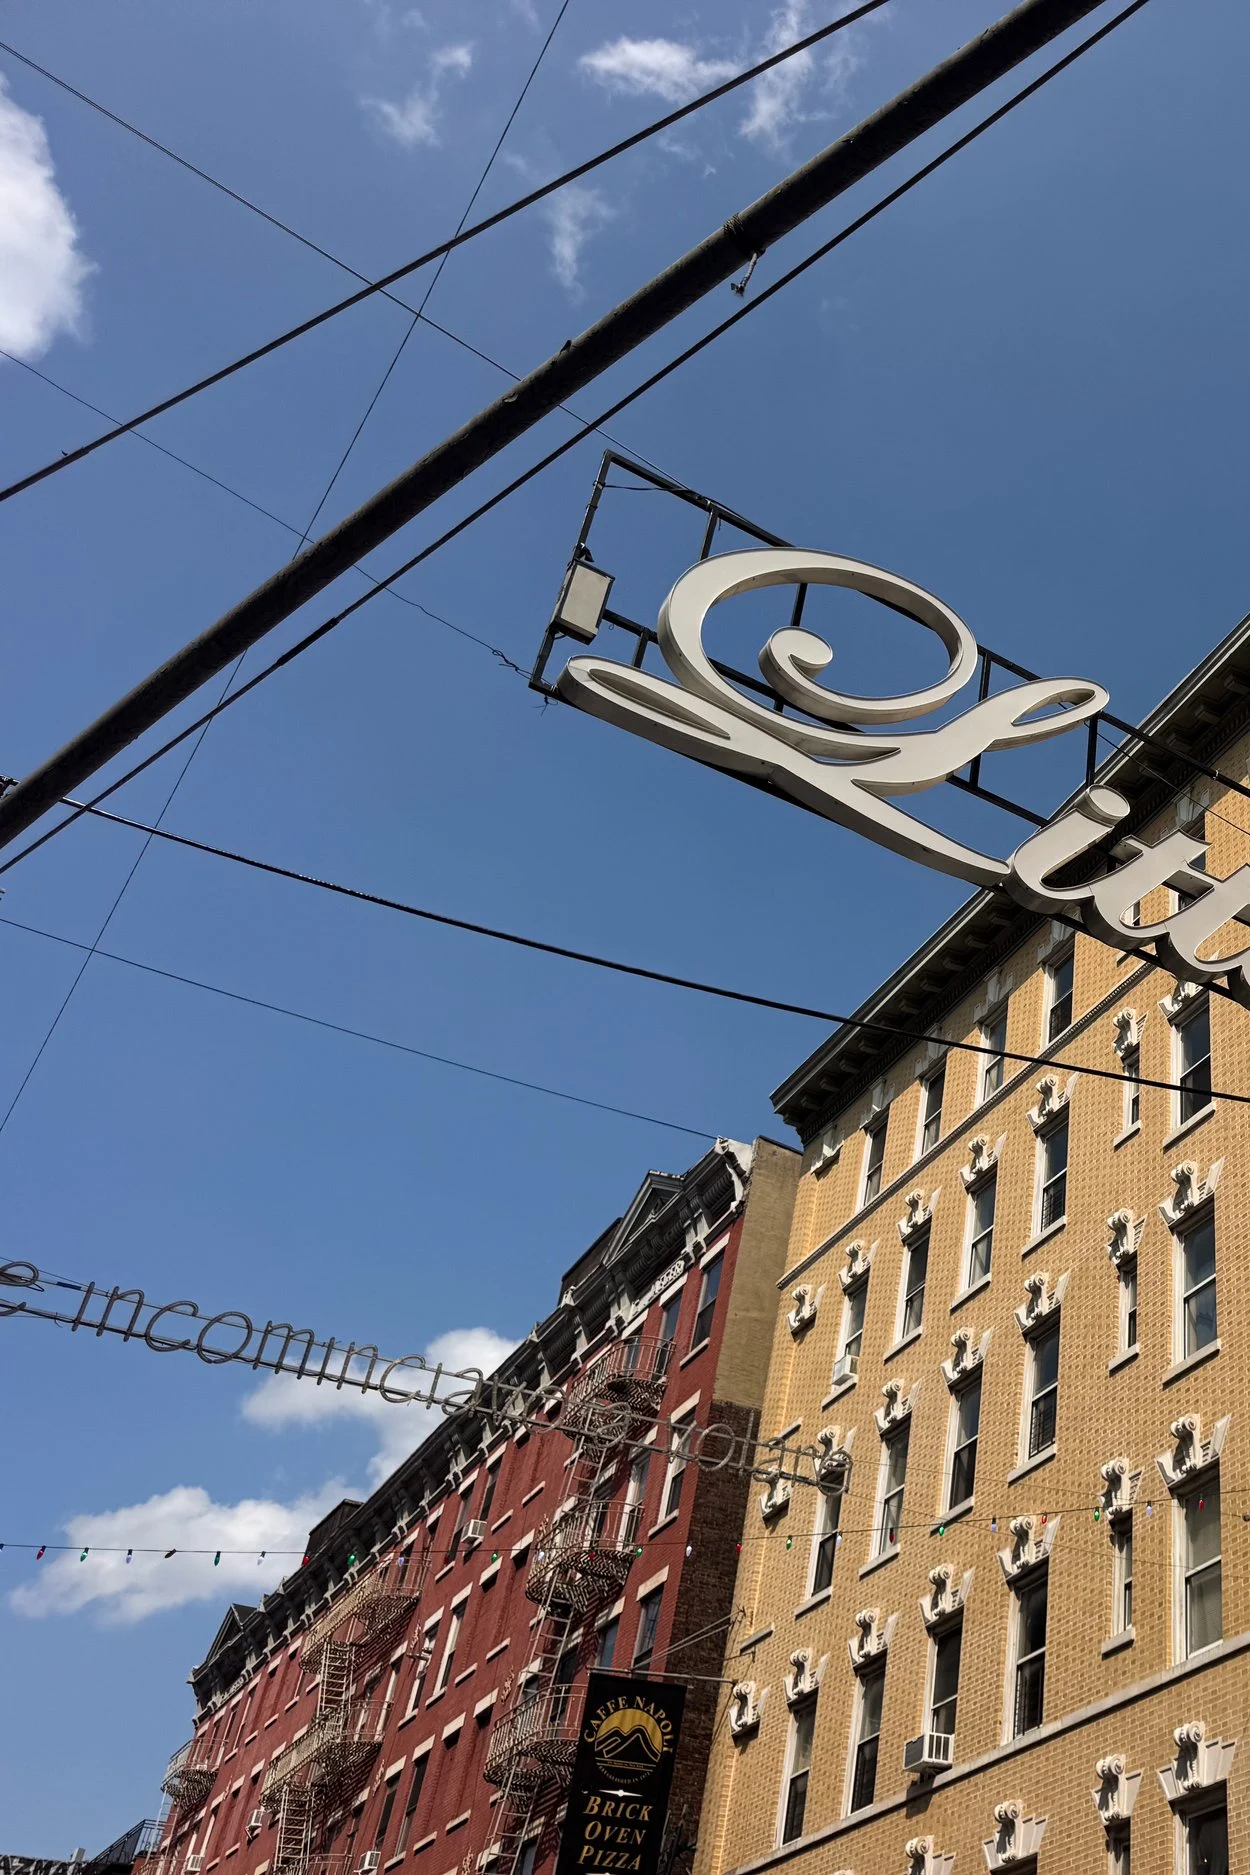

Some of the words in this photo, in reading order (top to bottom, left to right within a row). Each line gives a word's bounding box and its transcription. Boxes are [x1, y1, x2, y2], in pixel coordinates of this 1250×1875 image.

[584, 1696, 628, 1742] CAFFE
[633, 1696, 674, 1753] NAPOLI
[583, 1796, 653, 1821] BRICK
[584, 1821, 646, 1845] OVEN
[577, 1845, 641, 1870] PIZZA
